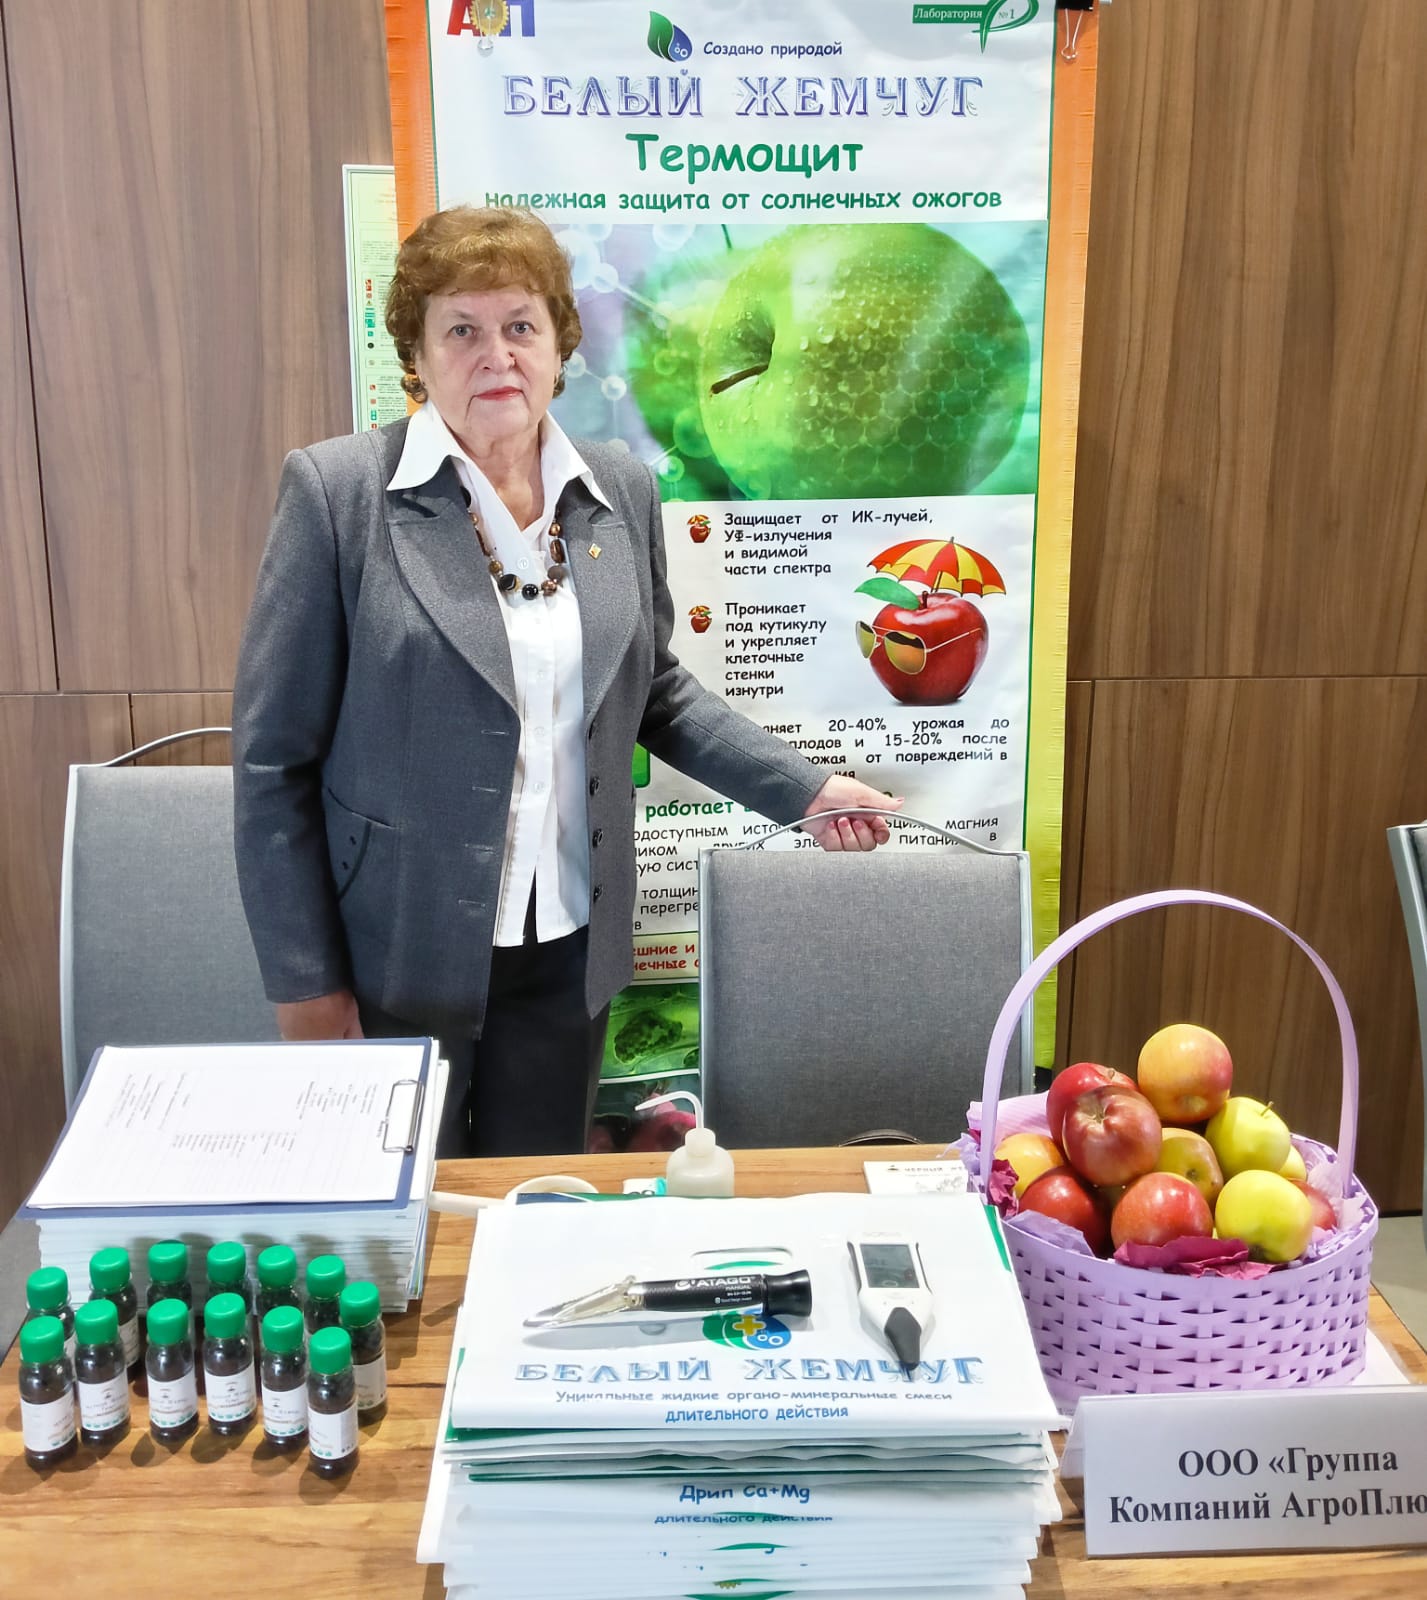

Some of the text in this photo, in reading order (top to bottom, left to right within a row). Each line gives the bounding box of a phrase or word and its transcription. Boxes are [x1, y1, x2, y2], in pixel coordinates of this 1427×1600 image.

[914, 7, 982, 20] Лаборатория
[703, 41, 842, 58] Создано природой
[502, 69, 983, 117] БЕЛЫЙ ЖЕМЧУГ
[625, 133, 864, 184] Термощит
[485, 192, 1002, 213] надежная защита от солнечных ожогов
[724, 509, 933, 527] Защищает от ИК-лучей,
[724, 530, 832, 543] УФ-излучения
[725, 545, 808, 559] и видимой
[725, 562, 831, 577] части спектра
[725, 602, 806, 617] Проникает
[725, 619, 826, 634] под кутикулу
[725, 635, 817, 650] и укрепляет
[725, 651, 804, 664] клеточные
[725, 668, 774, 680] стенки
[725, 684, 784, 698] изнутри
[828, 718, 887, 732] 20-40%
[912, 719, 965, 730] урожая
[991, 718, 1010, 730] до
[855, 739, 864, 747] и
[885, 732, 942, 746] 15-20%
[962, 734, 1007, 745] после
[866, 753, 882, 763] от
[896, 748, 993, 763] повреждений
[1000, 752, 1008, 760] в
[645, 800, 735, 822] работает
[634, 827, 728, 842] одоступным
[945, 817, 998, 830] магния
[990, 832, 997, 841] в
[685, 944, 695, 954] и
[697, 1276, 751, 1287] ATAGO
[514, 1357, 985, 1384] БЕЛЫЙ ЖЕМЧУГ
[661, 1391, 719, 1402] жидкие
[727, 1391, 898, 1403] органо-минеральные
[665, 1405, 849, 1424] длительного действия
[1178, 1447, 1399, 1480] ООО «Группа
[680, 1484, 810, 1504] Дрип Ca+Mg
[1109, 1488, 1427, 1525] Компаний АгроПлю
